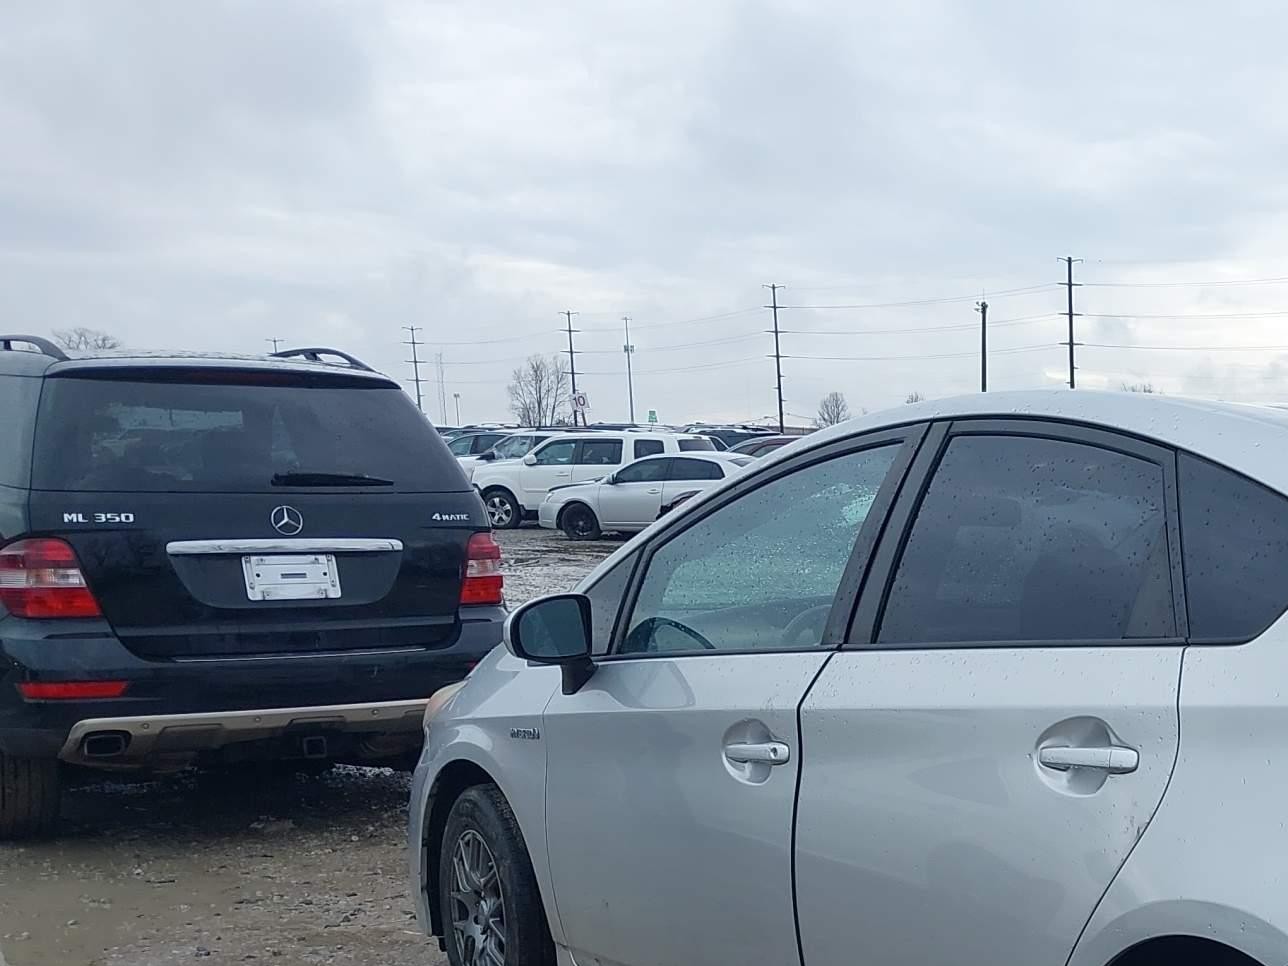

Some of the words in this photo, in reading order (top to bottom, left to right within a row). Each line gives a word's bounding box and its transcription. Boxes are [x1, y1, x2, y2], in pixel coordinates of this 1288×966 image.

[63, 513, 88, 523] ML
[93, 513, 134, 523] 350
[431, 512, 470, 521] 4MATIC
